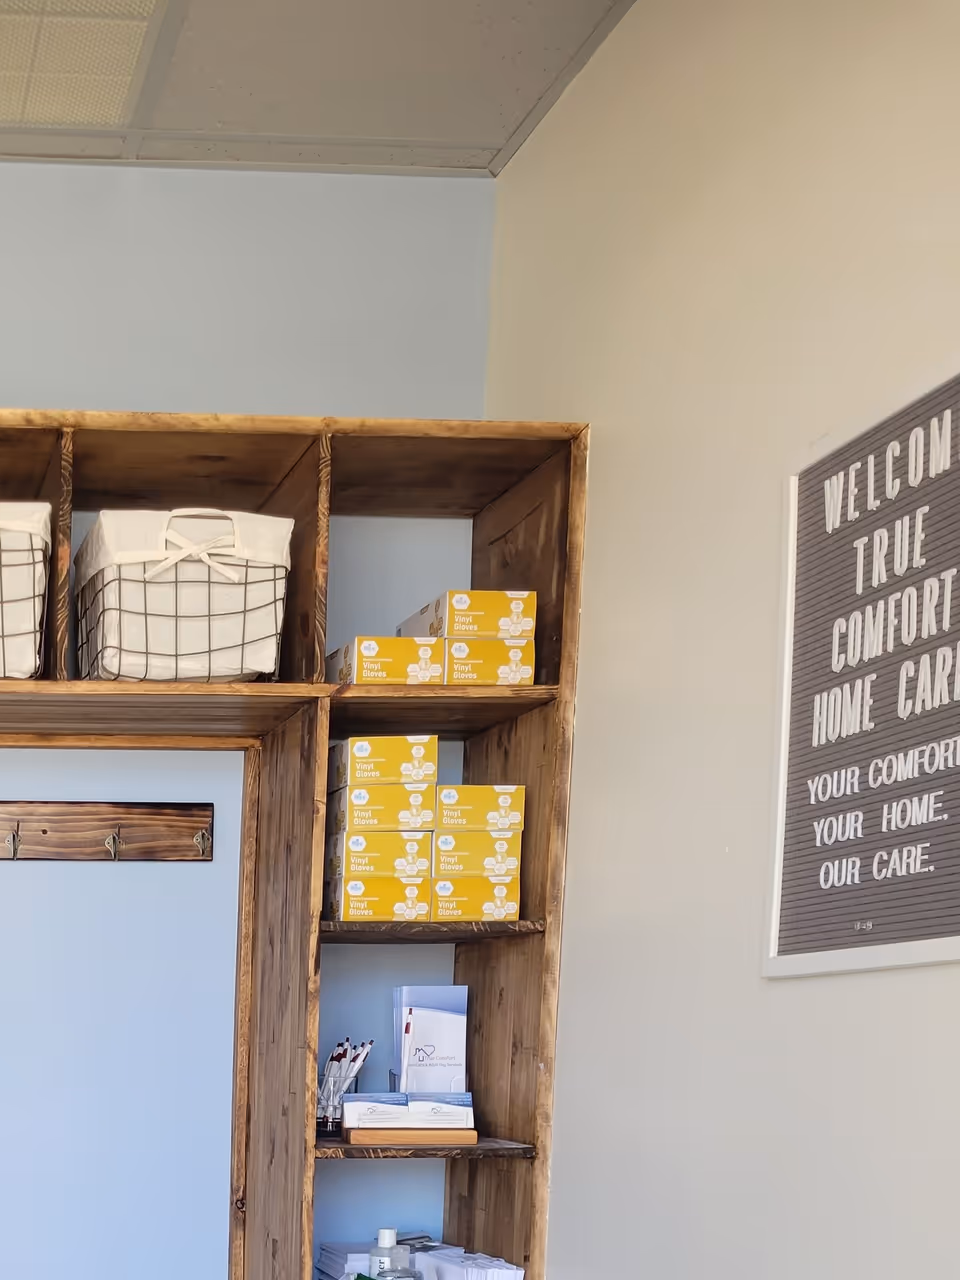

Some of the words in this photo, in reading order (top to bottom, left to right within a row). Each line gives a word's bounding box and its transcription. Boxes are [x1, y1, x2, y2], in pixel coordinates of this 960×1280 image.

[824, 408, 956, 534] WELCOM
[853, 505, 930, 595] TRUE
[454, 615, 472, 624] Vinyl
[831, 568, 958, 673] COMFORT
[453, 623, 478, 631] Gloves
[362, 662, 381, 670] Vinyl
[453, 663, 472, 672] Vinyl
[812, 673, 877, 747] HOME
[355, 763, 374, 771] Vinyl
[807, 766, 860, 805] YOUR
[353, 810, 372, 818] Vinyl
[443, 810, 461, 818] Vinyl
[813, 811, 864, 847] YOUR
[350, 856, 368, 864] Vinyl
[440, 855, 458, 864] Vinyl
[819, 856, 861, 890] OUR
[872, 842, 935, 881] CARE.
[349, 901, 367, 909] Vinyl
[438, 901, 456, 909] Vinyl
